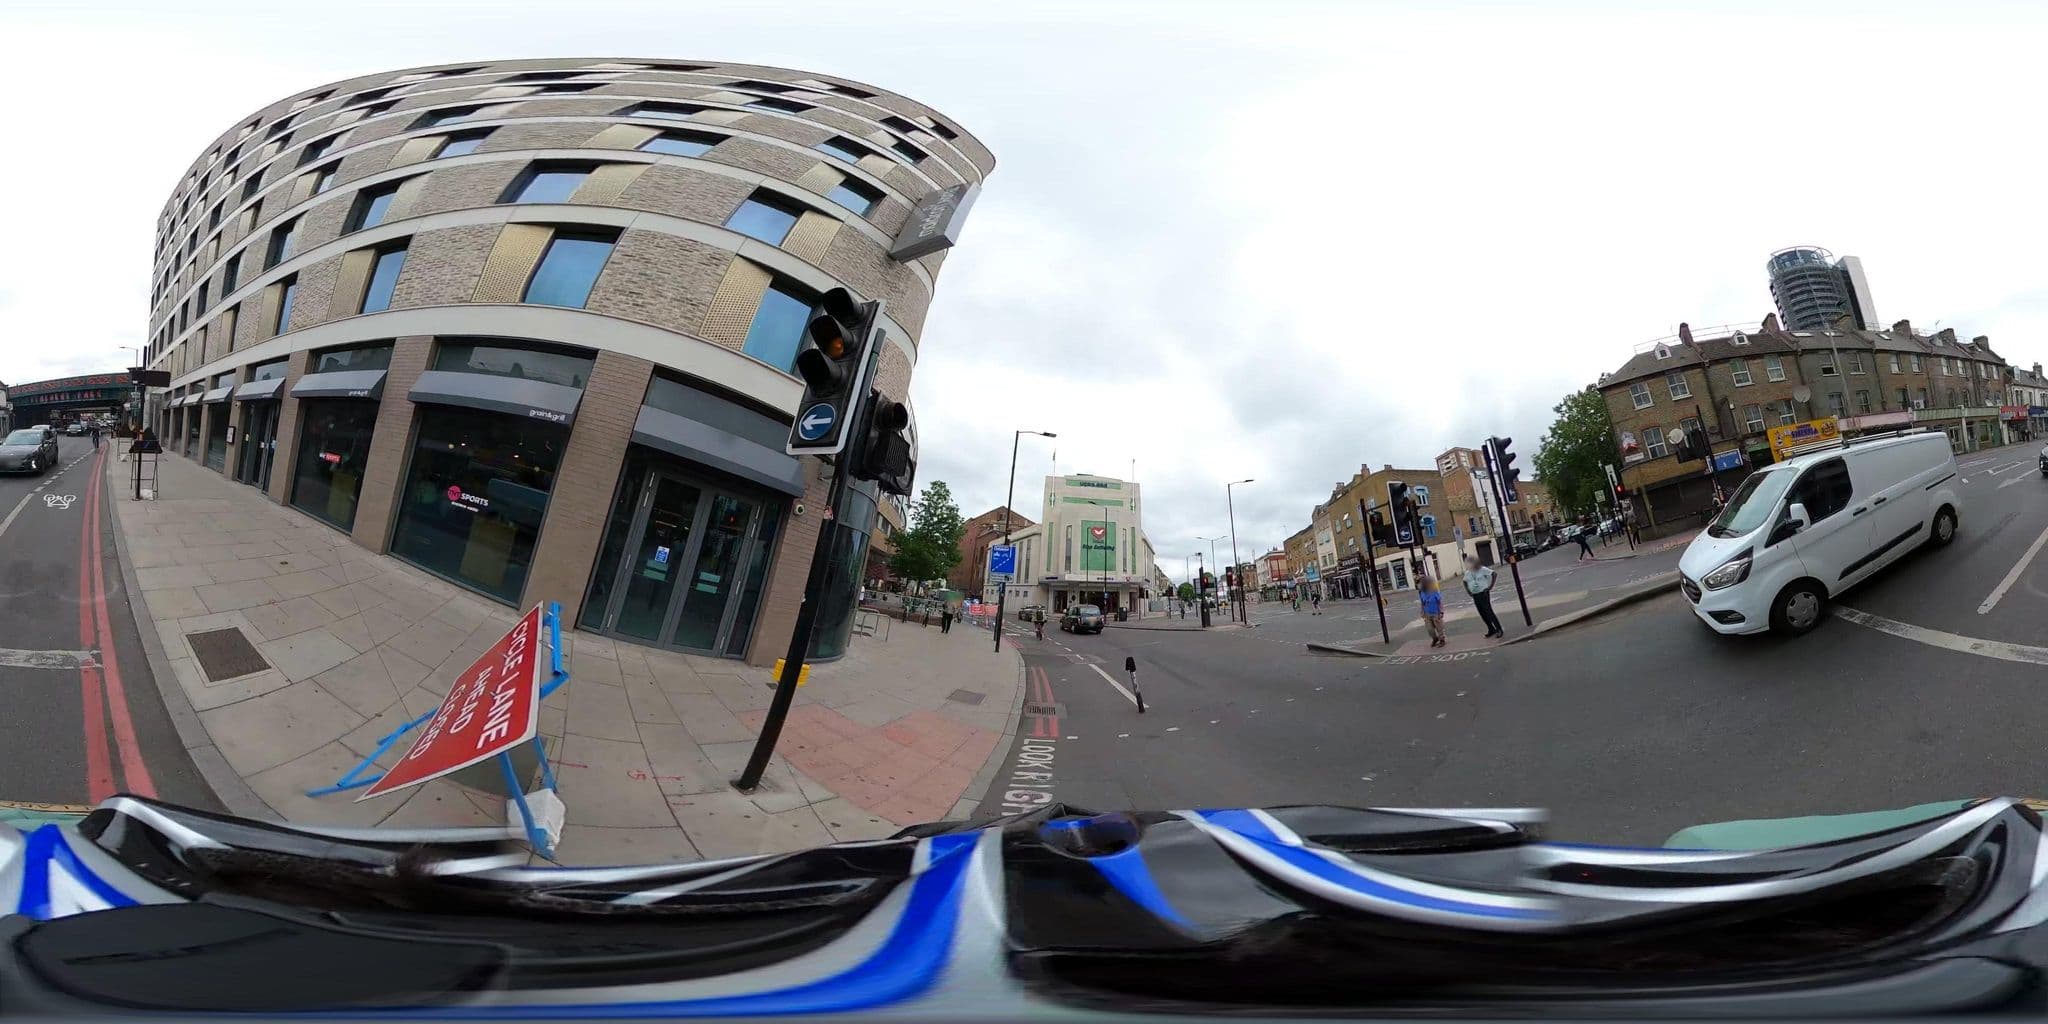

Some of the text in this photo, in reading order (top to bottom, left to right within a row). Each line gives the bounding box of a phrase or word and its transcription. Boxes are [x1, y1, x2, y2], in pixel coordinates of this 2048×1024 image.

[461, 493, 489, 507] SPORTS
[409, 684, 466, 761] CLOSED
[450, 665, 493, 735] AHEAD
[476, 621, 528, 750] CYCLE LANE
[1001, 738, 1057, 816] LOOK RIGH
